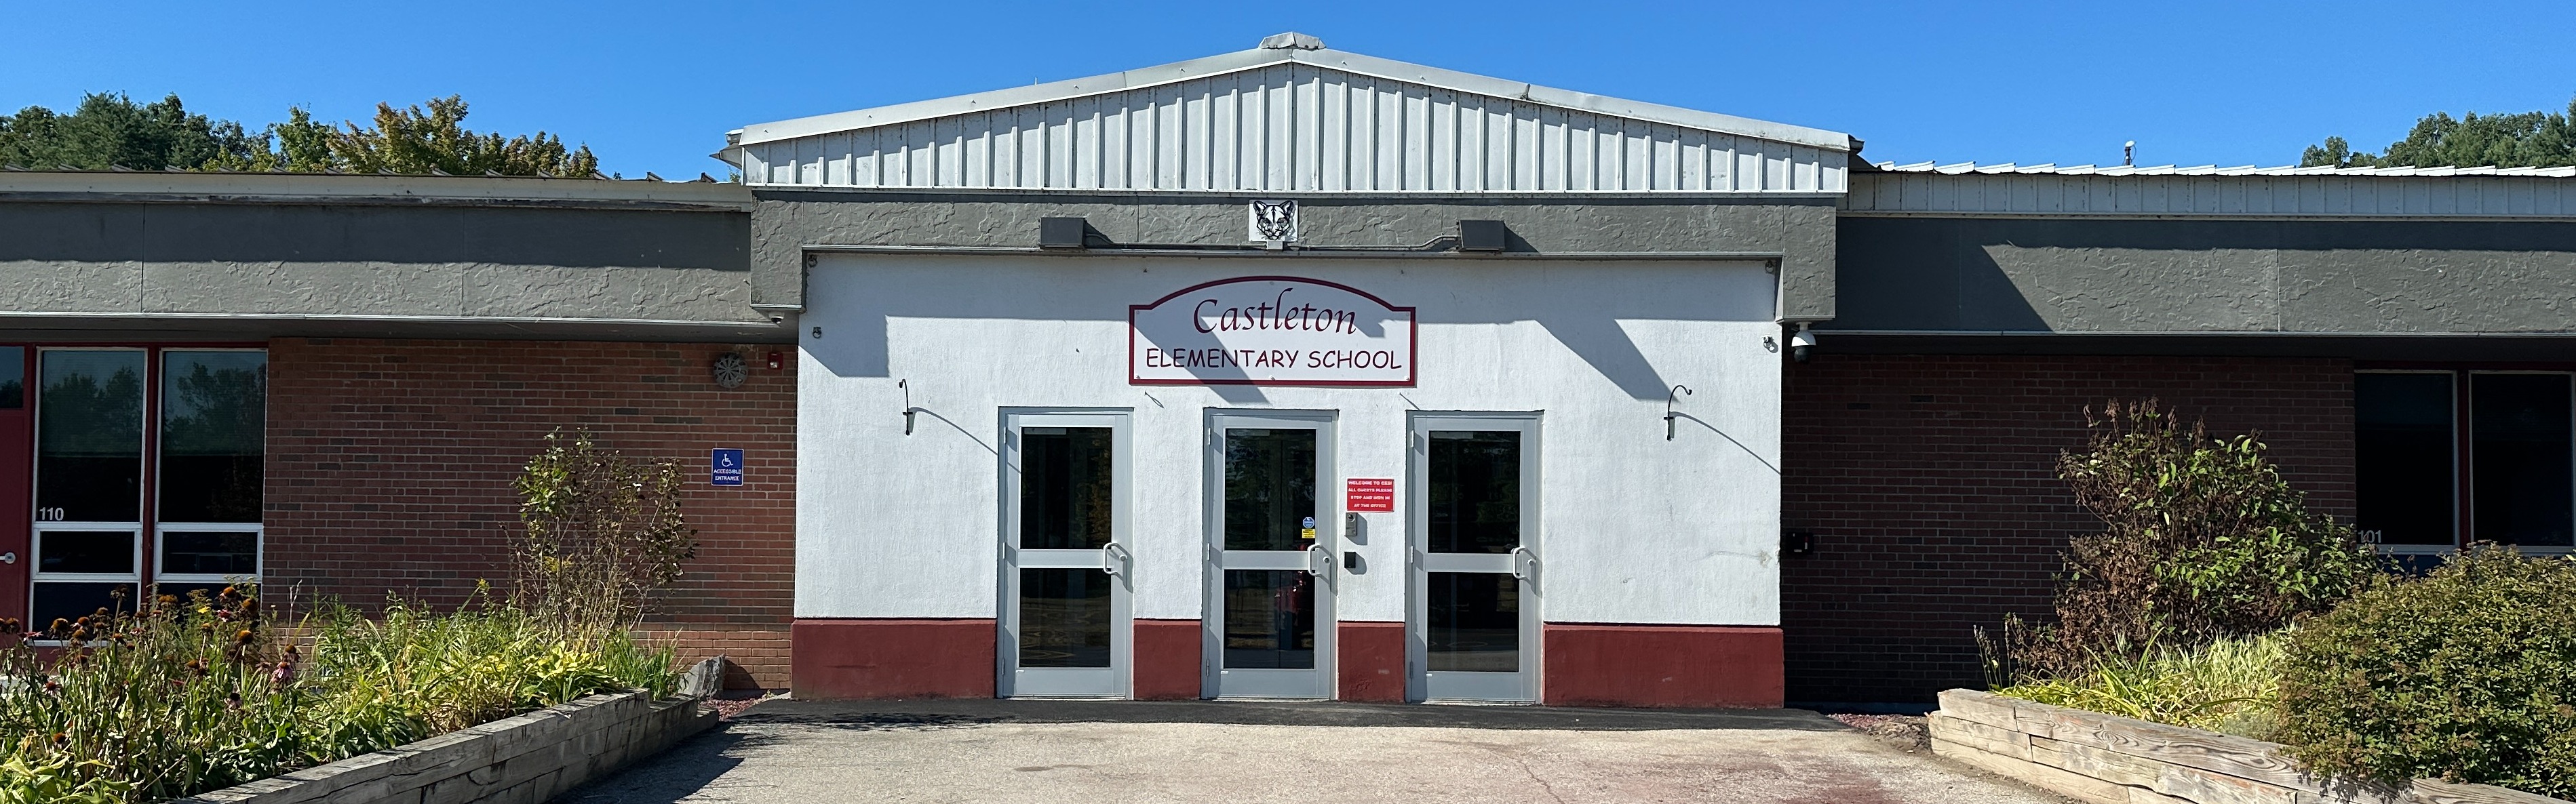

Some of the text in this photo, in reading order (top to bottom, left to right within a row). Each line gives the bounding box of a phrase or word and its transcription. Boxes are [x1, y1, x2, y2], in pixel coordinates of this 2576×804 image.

[1194, 287, 1357, 334] Castleton
[1146, 348, 1402, 369] ELEMENTARY SCHOOL
[39, 507, 64, 521] 110
[2358, 529, 2381, 544] 101
